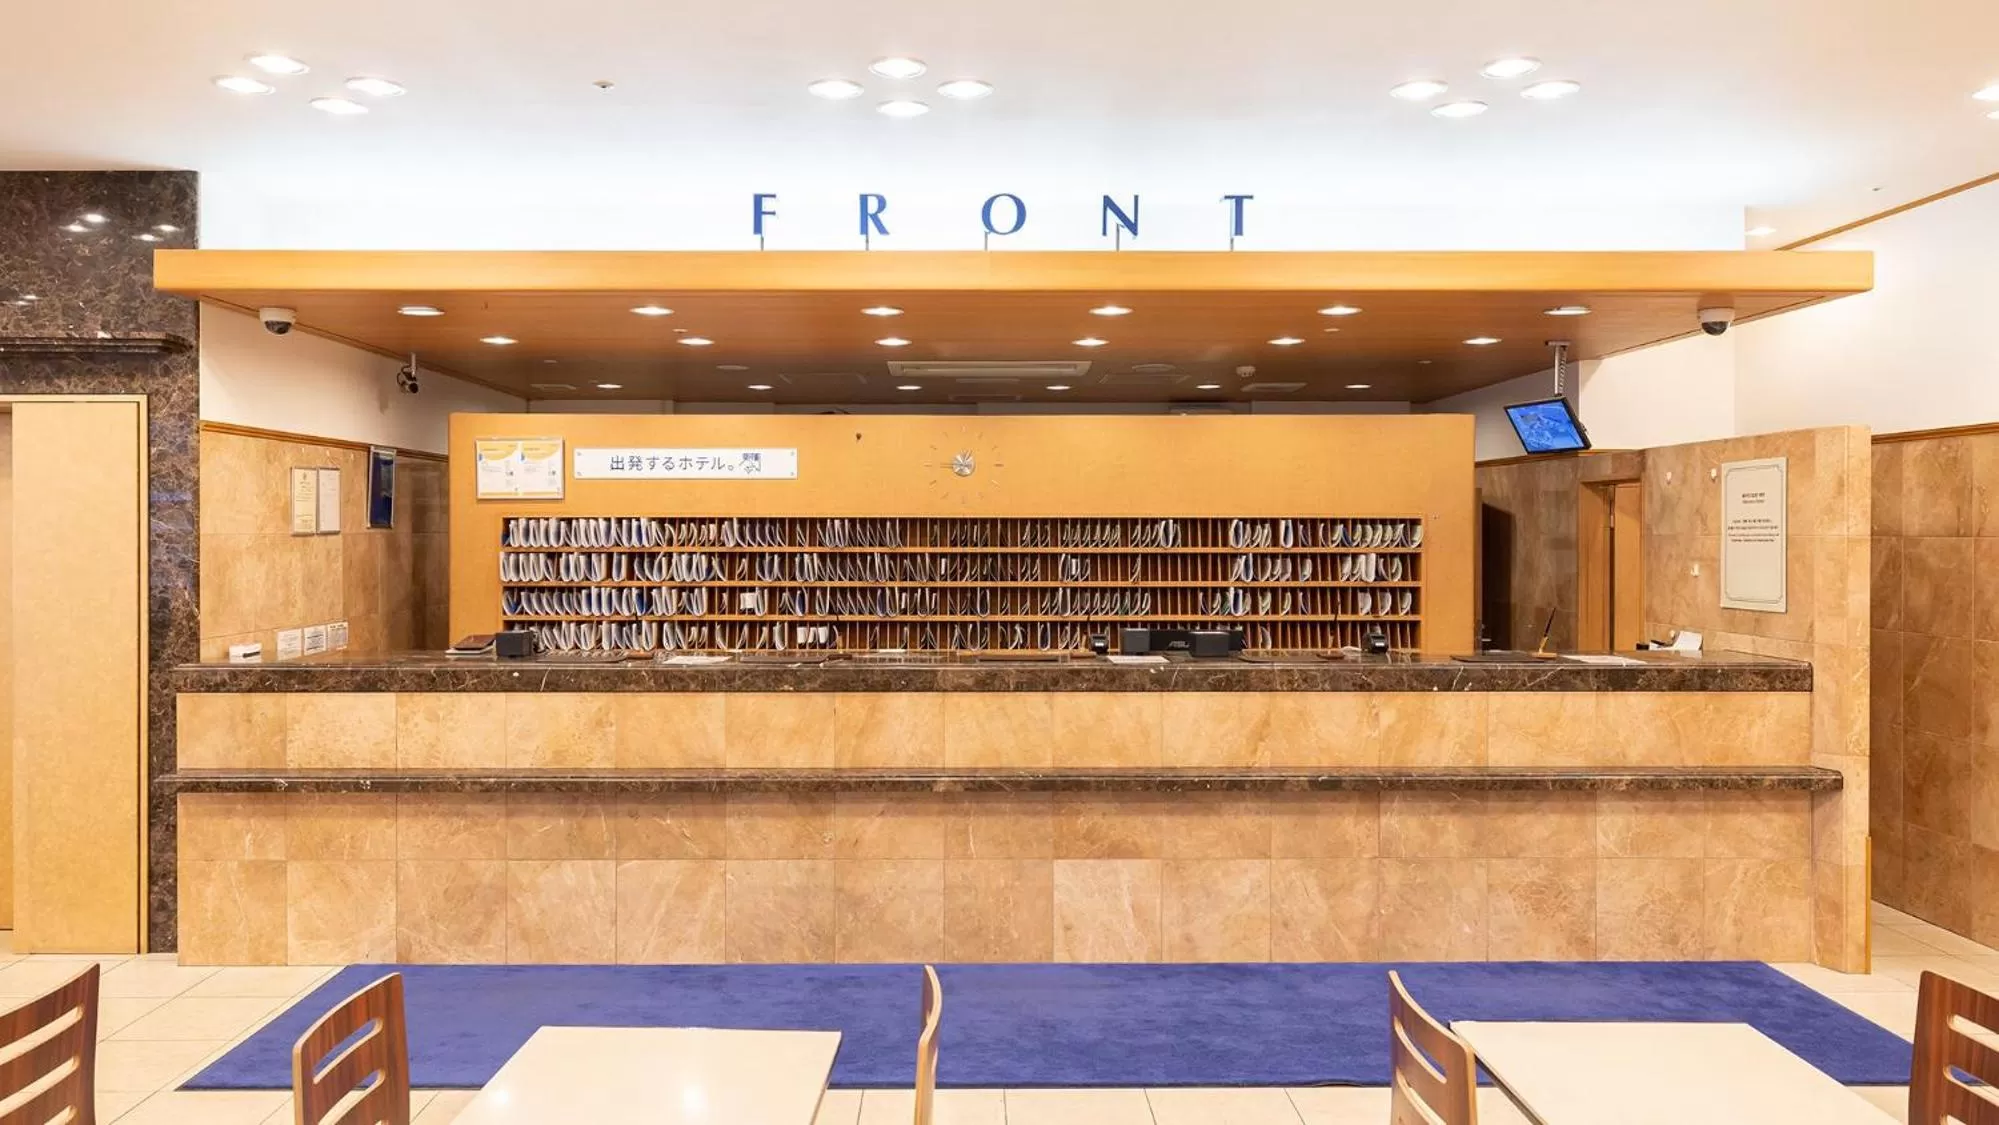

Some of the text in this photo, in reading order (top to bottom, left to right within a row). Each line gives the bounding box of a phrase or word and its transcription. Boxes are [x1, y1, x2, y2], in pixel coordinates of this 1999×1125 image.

[753, 193, 1254, 237] FRONT
[609, 455, 735, 472] 出発するホテル。
